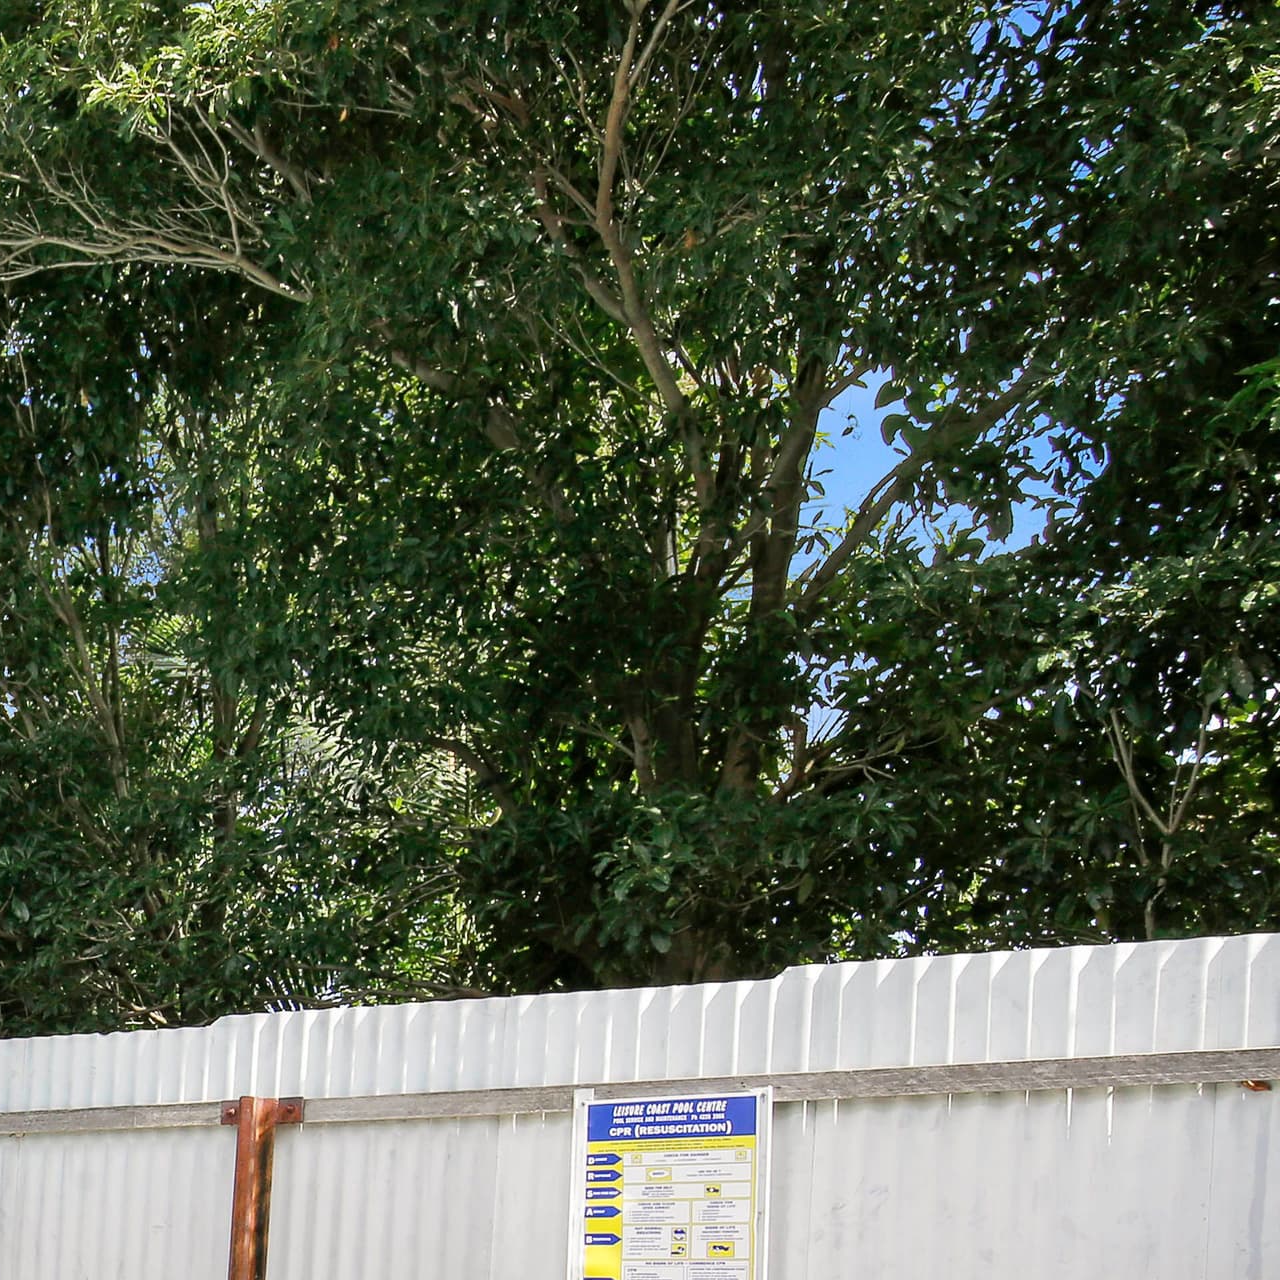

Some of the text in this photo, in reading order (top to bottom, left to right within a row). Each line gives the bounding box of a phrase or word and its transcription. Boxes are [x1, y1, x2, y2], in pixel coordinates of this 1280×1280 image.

[613, 1100, 728, 1117] LEISURE COAST POOL CENTRE
[609, 1120, 733, 1138] CPR (RESUSCITATION)
